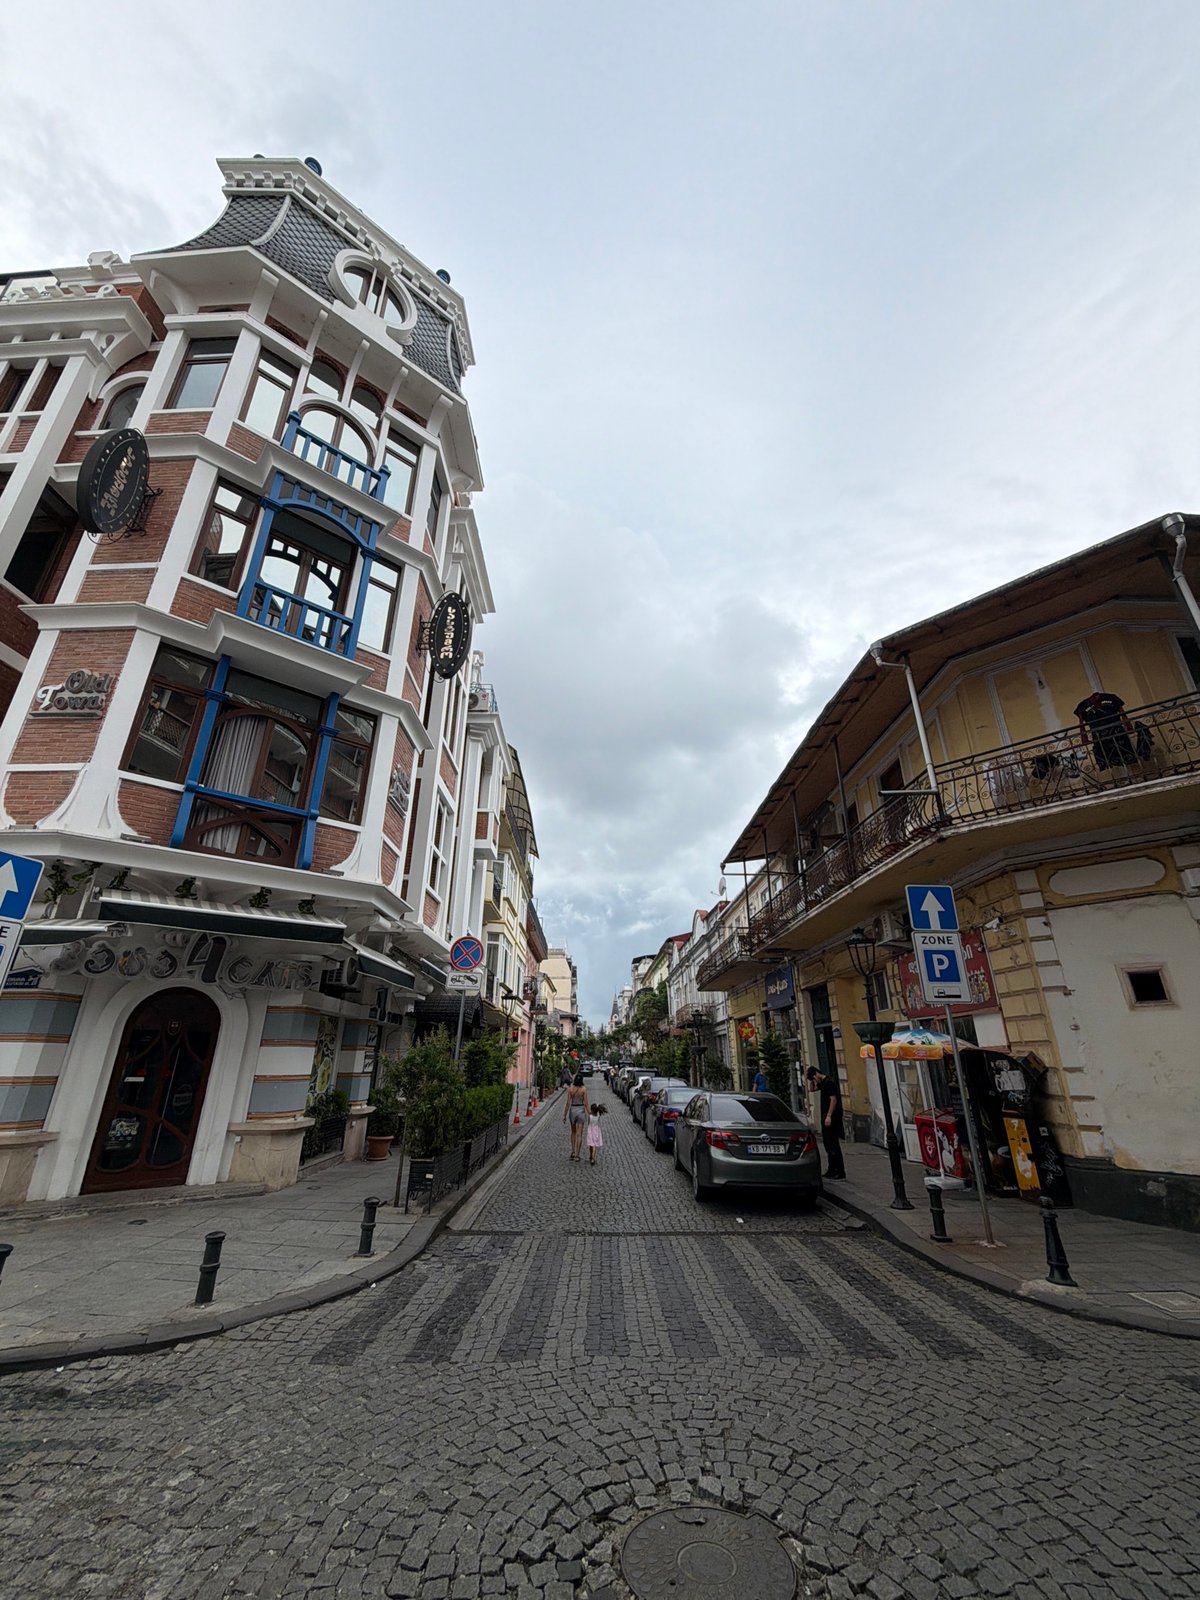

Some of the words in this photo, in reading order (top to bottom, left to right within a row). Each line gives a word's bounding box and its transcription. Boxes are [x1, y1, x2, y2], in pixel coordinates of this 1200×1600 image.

[65, 671, 110, 694] Old
[37, 684, 104, 711] Town
[921, 936, 954, 945] ZONE
[228, 956, 314, 988] CATS
[932, 953, 950, 978] P
